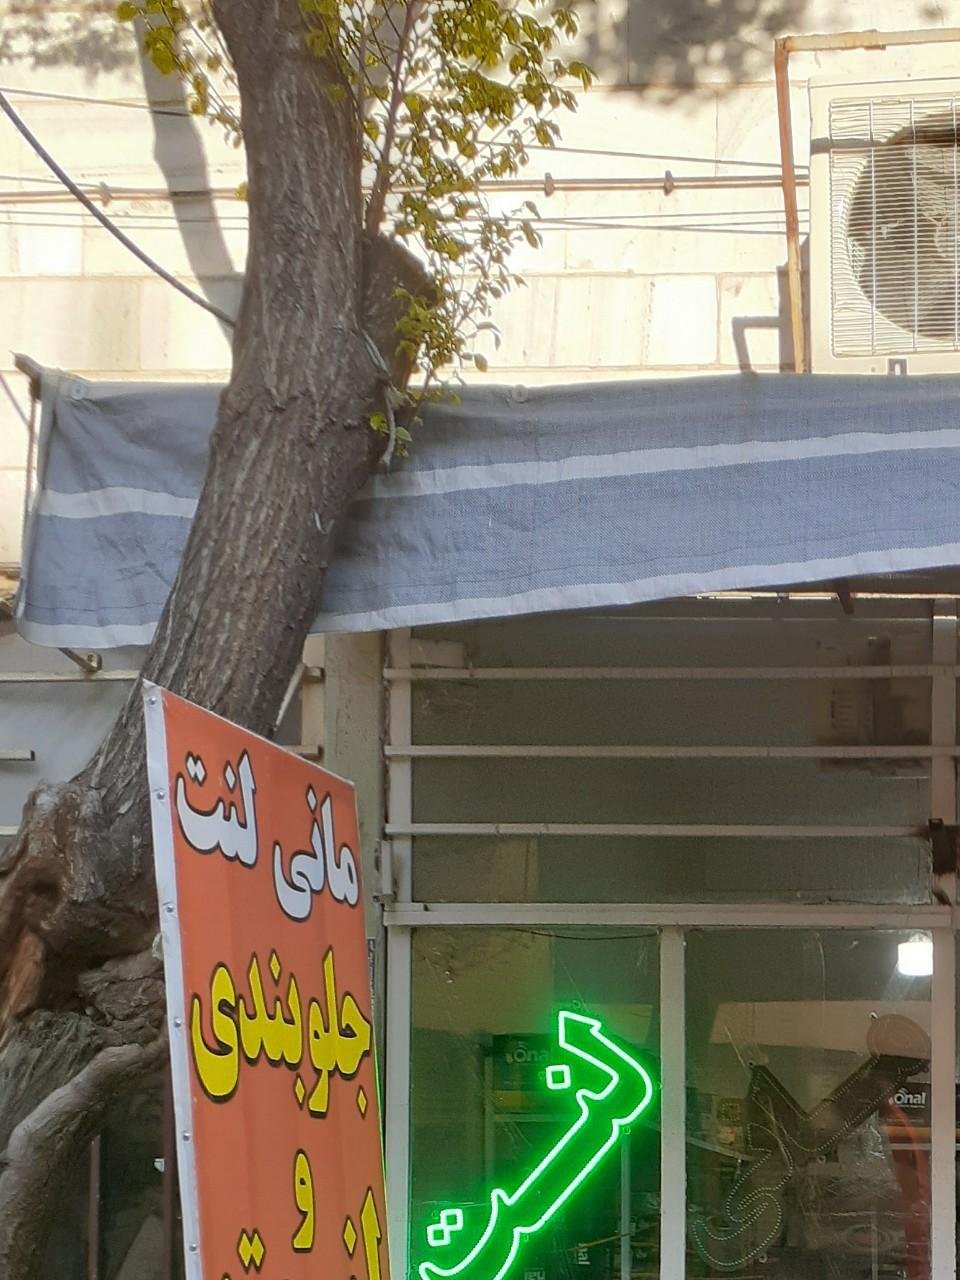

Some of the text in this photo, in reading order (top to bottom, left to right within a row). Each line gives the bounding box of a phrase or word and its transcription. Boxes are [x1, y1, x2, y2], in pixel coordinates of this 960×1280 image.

[174, 749, 360, 921] مانی لنت
[189, 945, 372, 1119] جلوبندی
[290, 1147, 316, 1251] و
